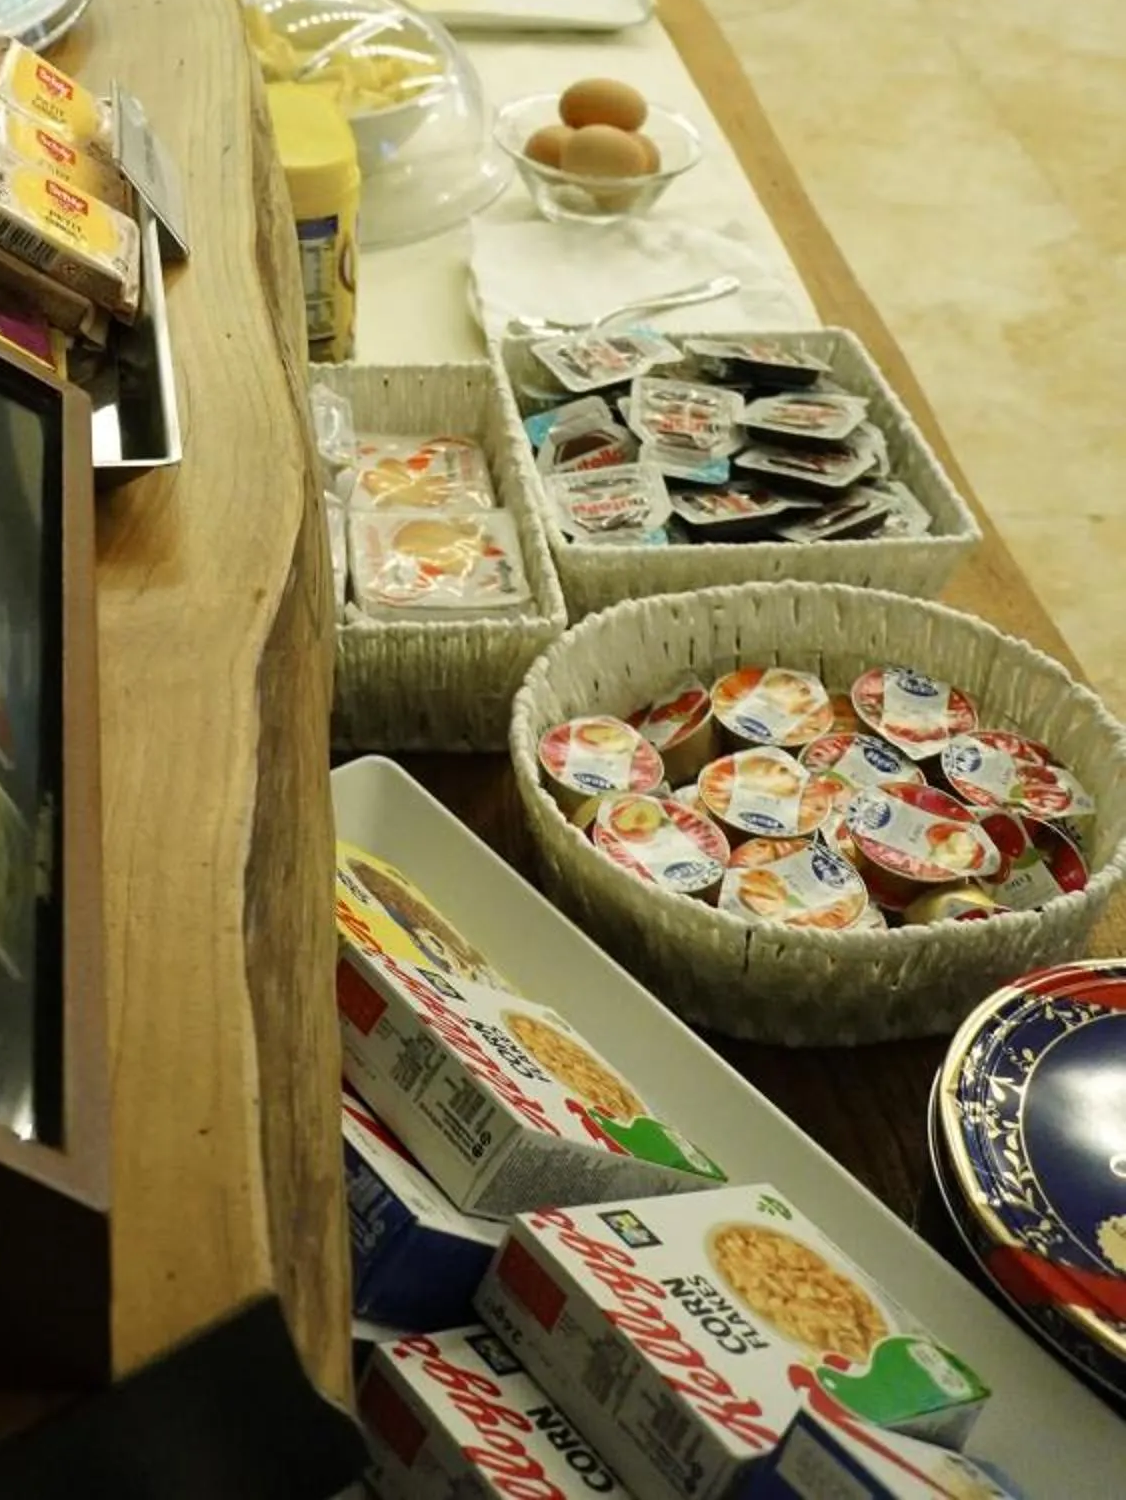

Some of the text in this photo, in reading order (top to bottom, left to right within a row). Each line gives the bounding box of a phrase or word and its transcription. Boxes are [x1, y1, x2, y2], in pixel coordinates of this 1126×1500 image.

[466, 1018, 535, 1080] CORN
[530, 1205, 780, 1450] Kellogg's
[660, 1277, 748, 1356] CORN
[691, 1274, 770, 1352] FLAKES
[526, 1404, 615, 1493] CORN
